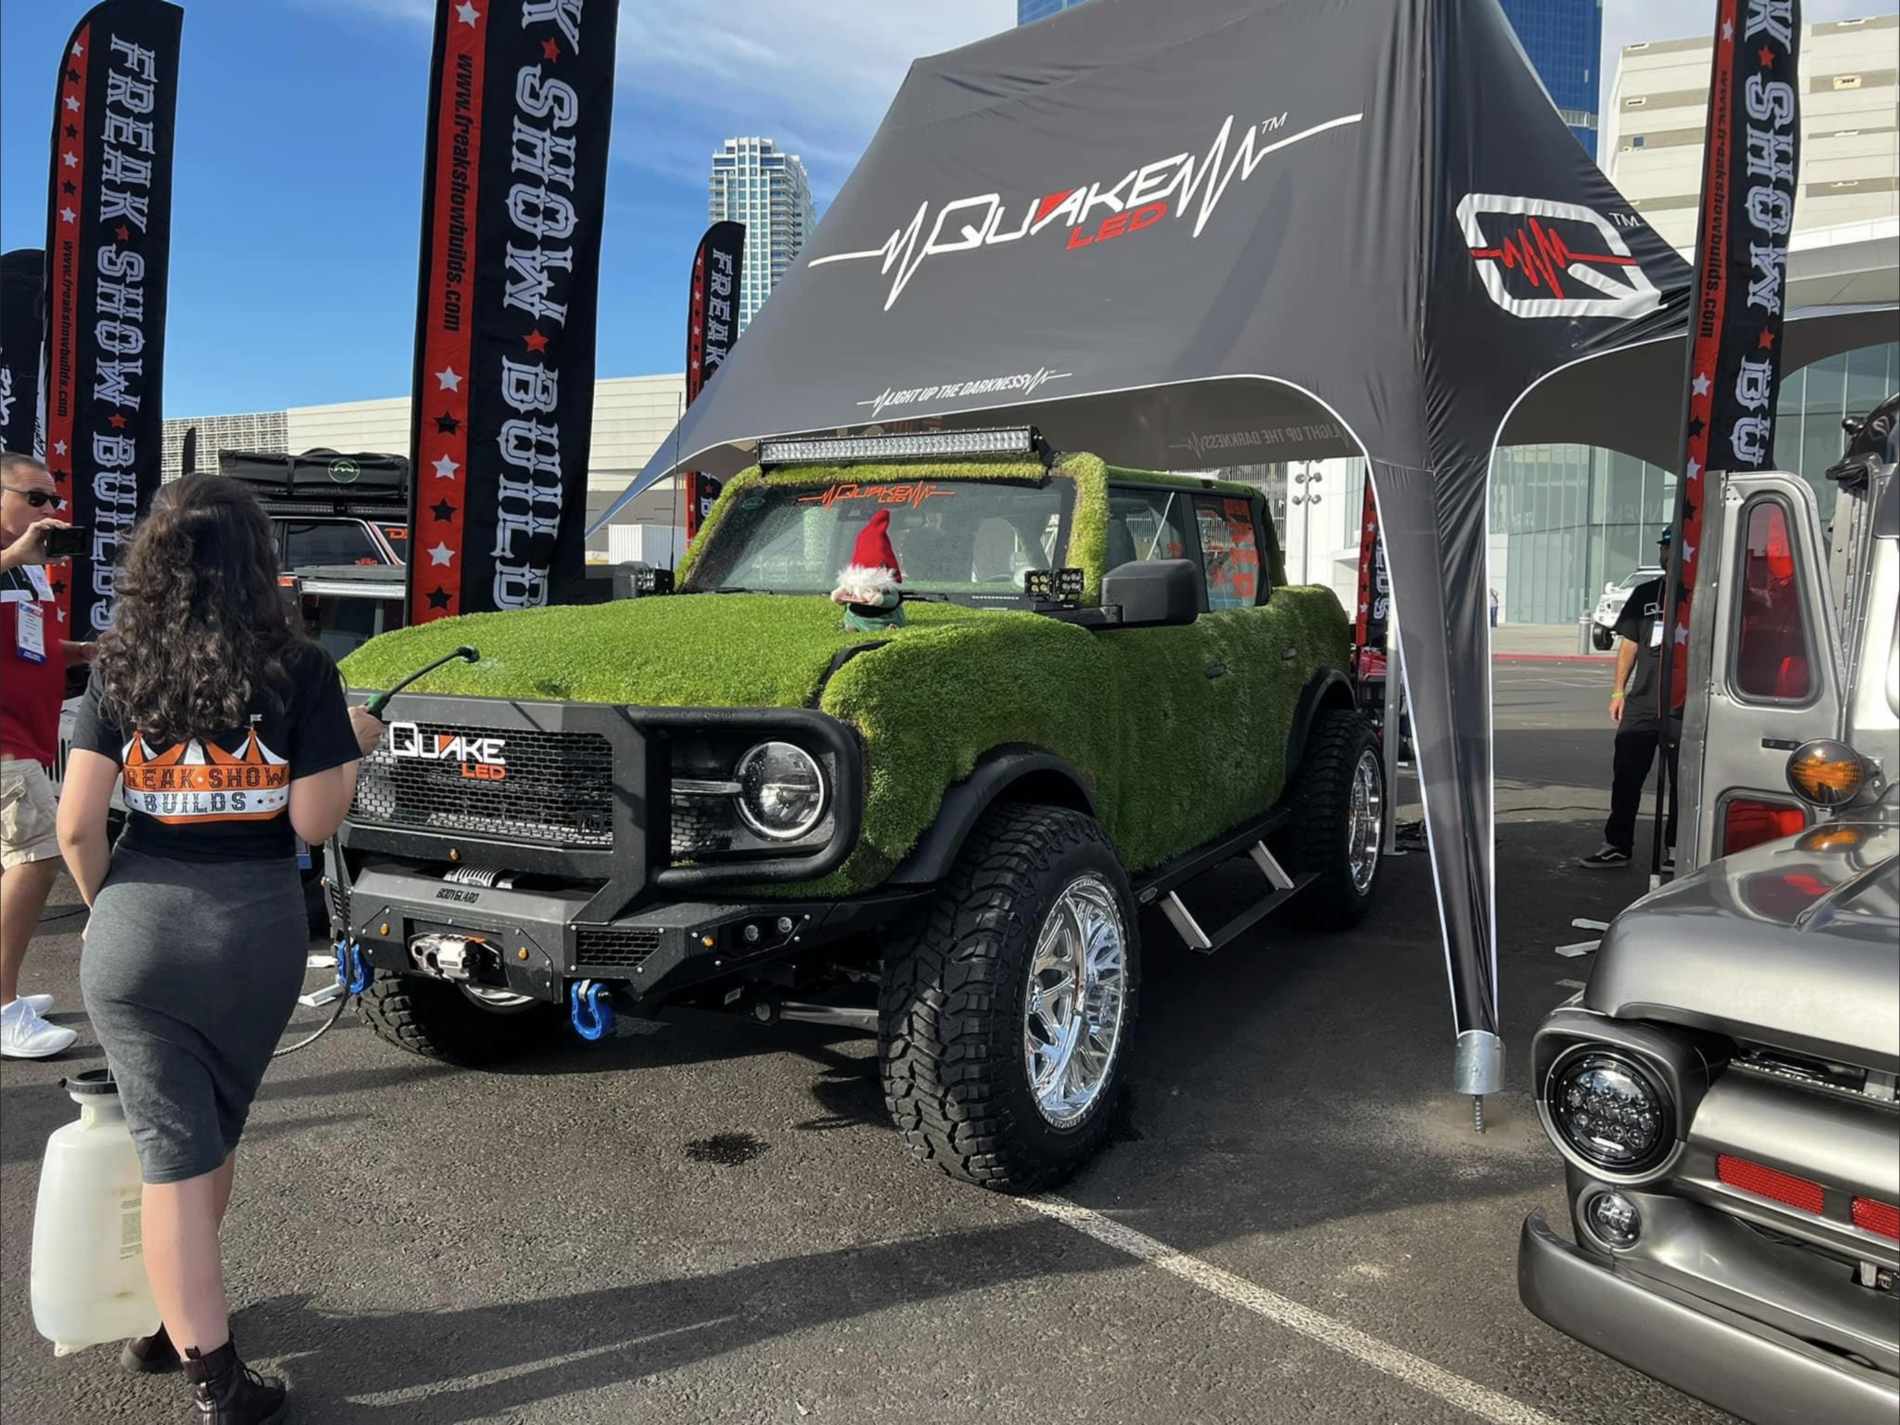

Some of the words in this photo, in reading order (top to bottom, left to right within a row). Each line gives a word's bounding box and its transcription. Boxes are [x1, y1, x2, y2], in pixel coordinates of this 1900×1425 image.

[100, 33, 160, 235] FREAK
[443, 53, 473, 332] www.freakshowbuilds.com
[503, 64, 580, 329] SHOW
[924, 151, 1190, 255] QUAKE
[1066, 202, 1169, 251] LED
[1743, 72, 1796, 316] SHOW
[57, 240, 74, 418] www.freakshowbuilds.com
[93, 244, 147, 414] SHOW
[704, 247, 734, 367] FREAK
[885, 388, 920, 407] LIGHT
[918, 387, 939, 402] UP
[935, 382, 965, 400] THE
[959, 373, 1030, 397] DARKNESS
[126, 768, 197, 789] REAK
[208, 766, 288, 788] SHOW
[389, 721, 506, 765] QUAKE
[462, 761, 506, 781] LED
[144, 792, 247, 814] BUILDS
